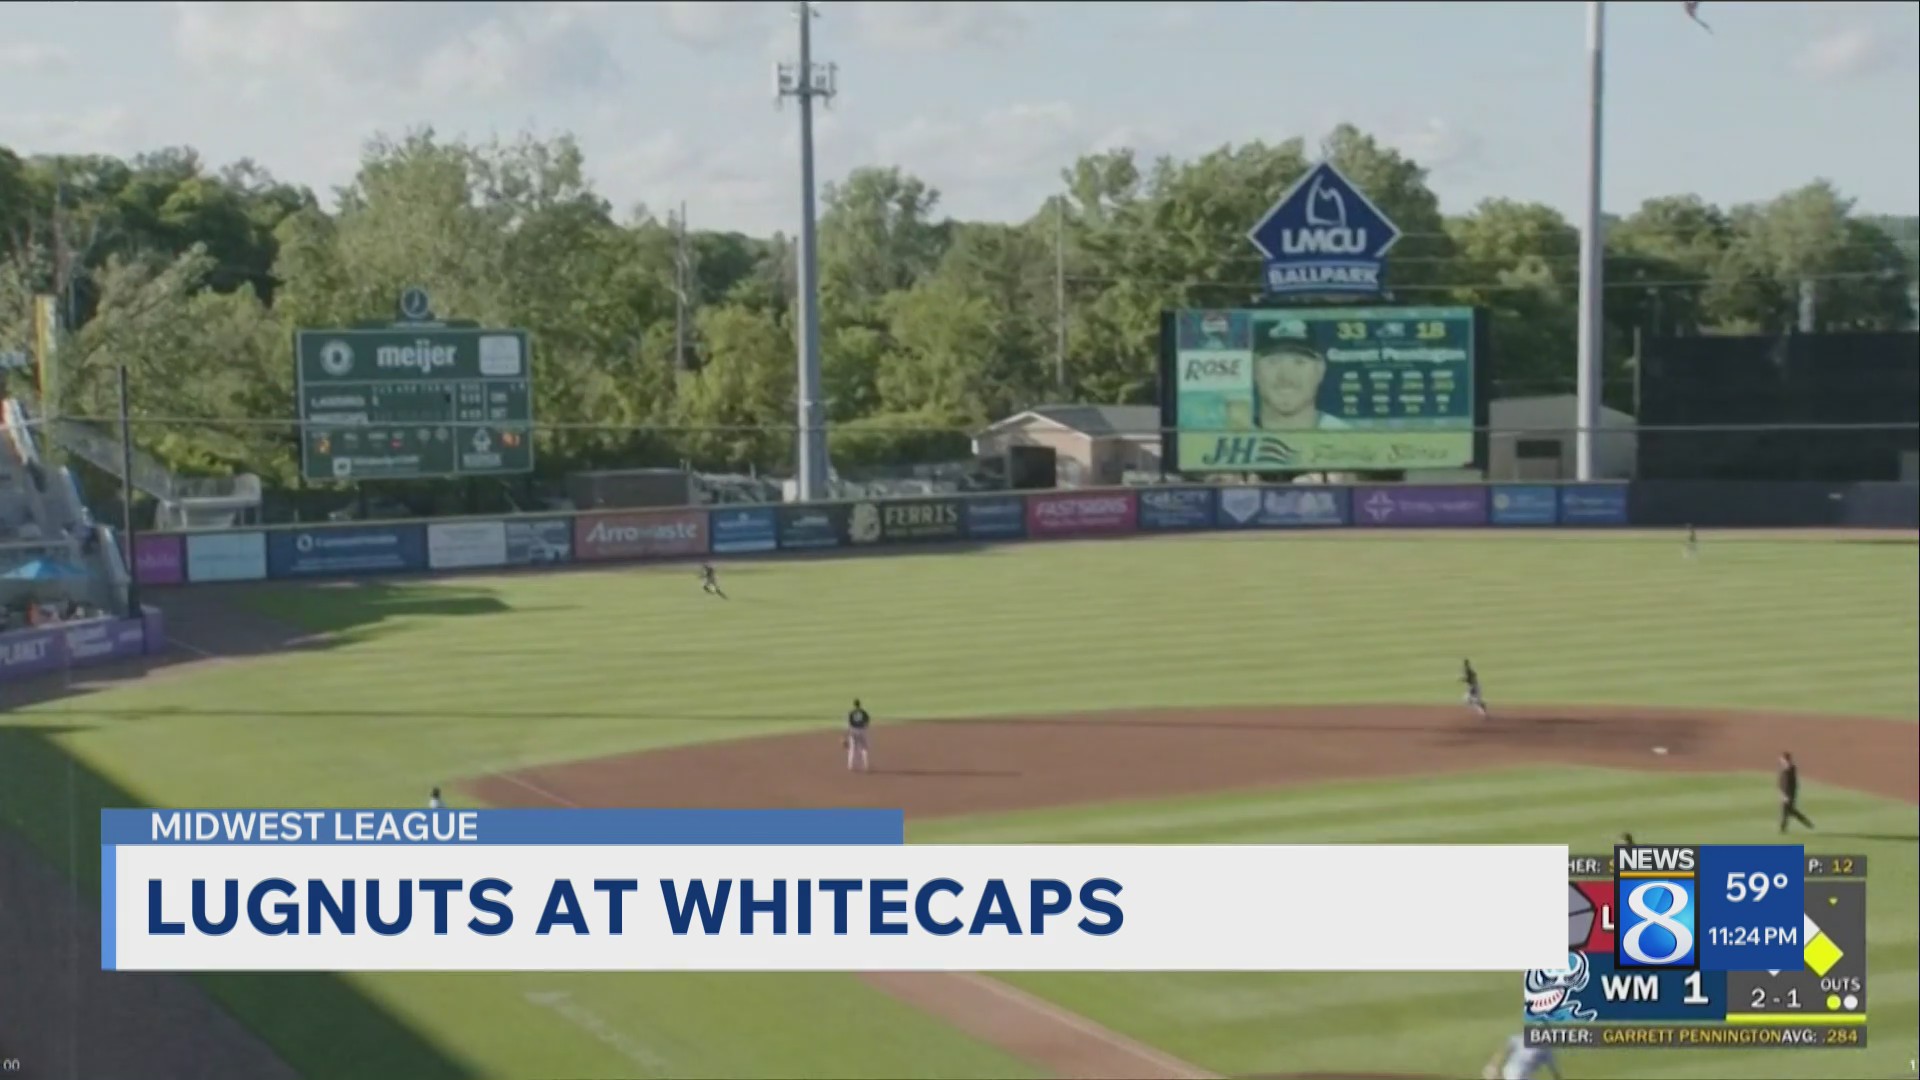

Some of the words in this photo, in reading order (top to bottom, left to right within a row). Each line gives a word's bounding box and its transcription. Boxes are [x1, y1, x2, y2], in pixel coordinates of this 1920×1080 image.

[1281, 229, 1367, 254] LMCU
[1268, 266, 1378, 287] BALLPARK
[1336, 322, 1367, 340] 33
[376, 338, 457, 373] meijer
[1184, 358, 1243, 381] ROSE
[884, 504, 958, 526] FERRIS
